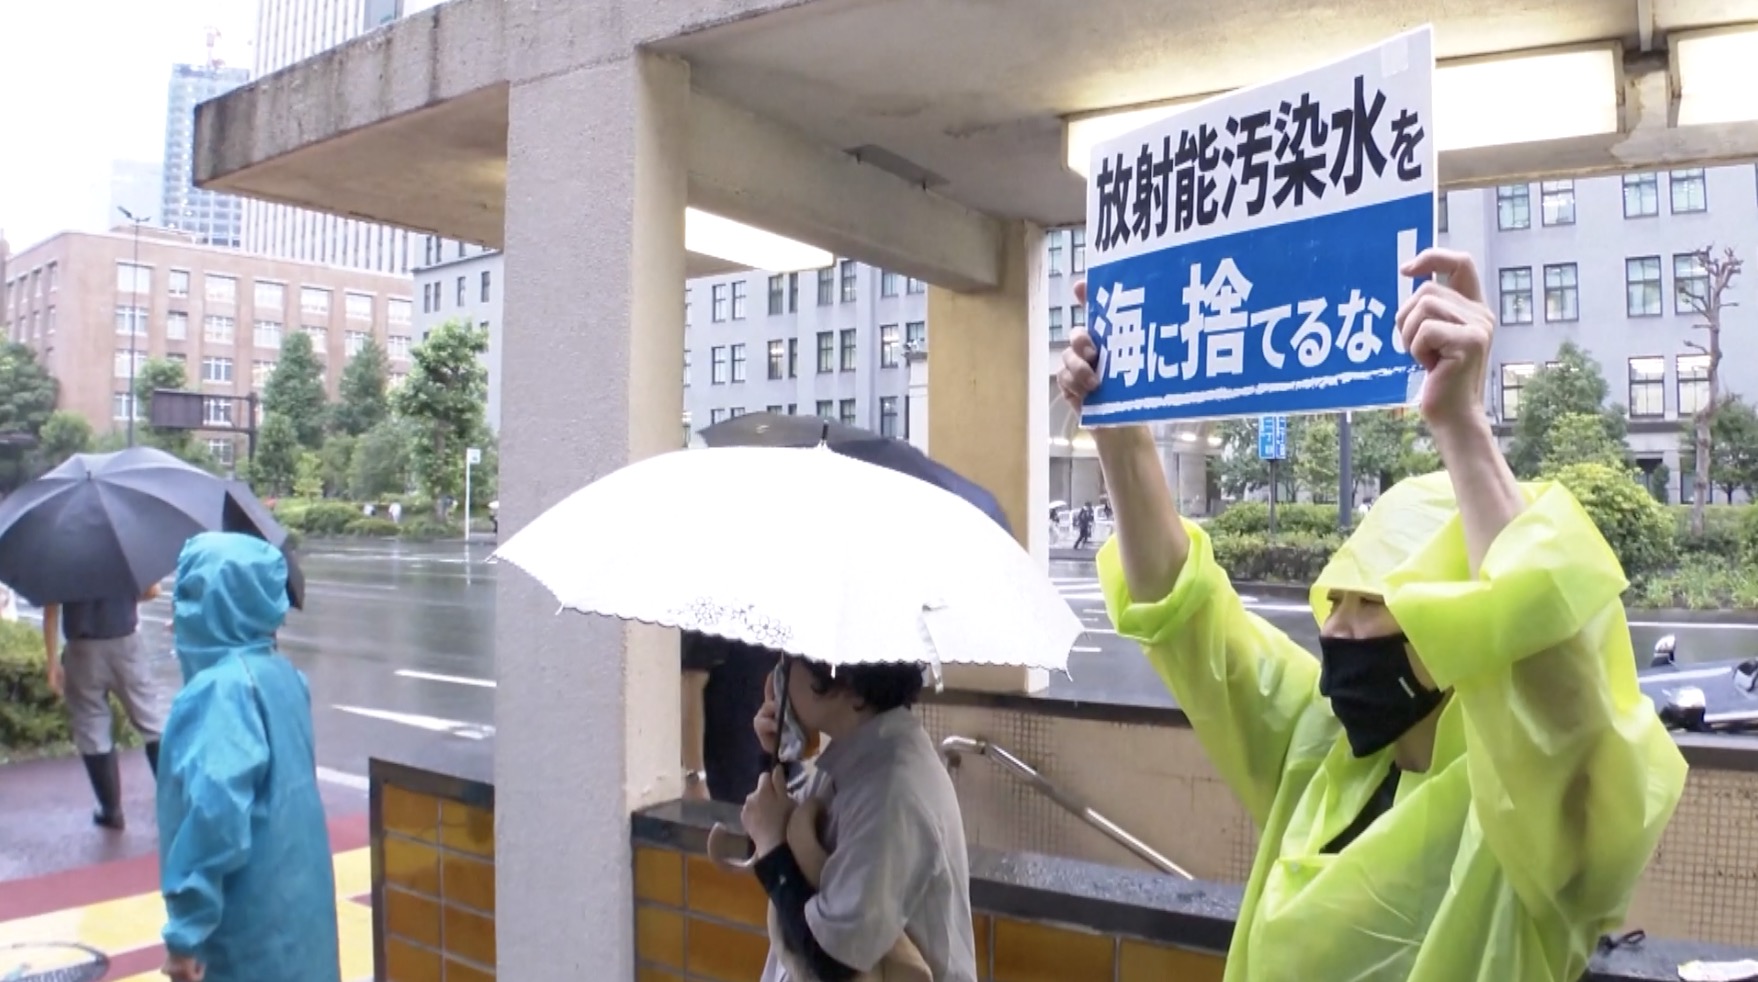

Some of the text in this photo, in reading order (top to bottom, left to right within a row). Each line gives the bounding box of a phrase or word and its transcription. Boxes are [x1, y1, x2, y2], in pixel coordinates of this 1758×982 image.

[1095, 75, 1424, 251] 放射能汚染水を
